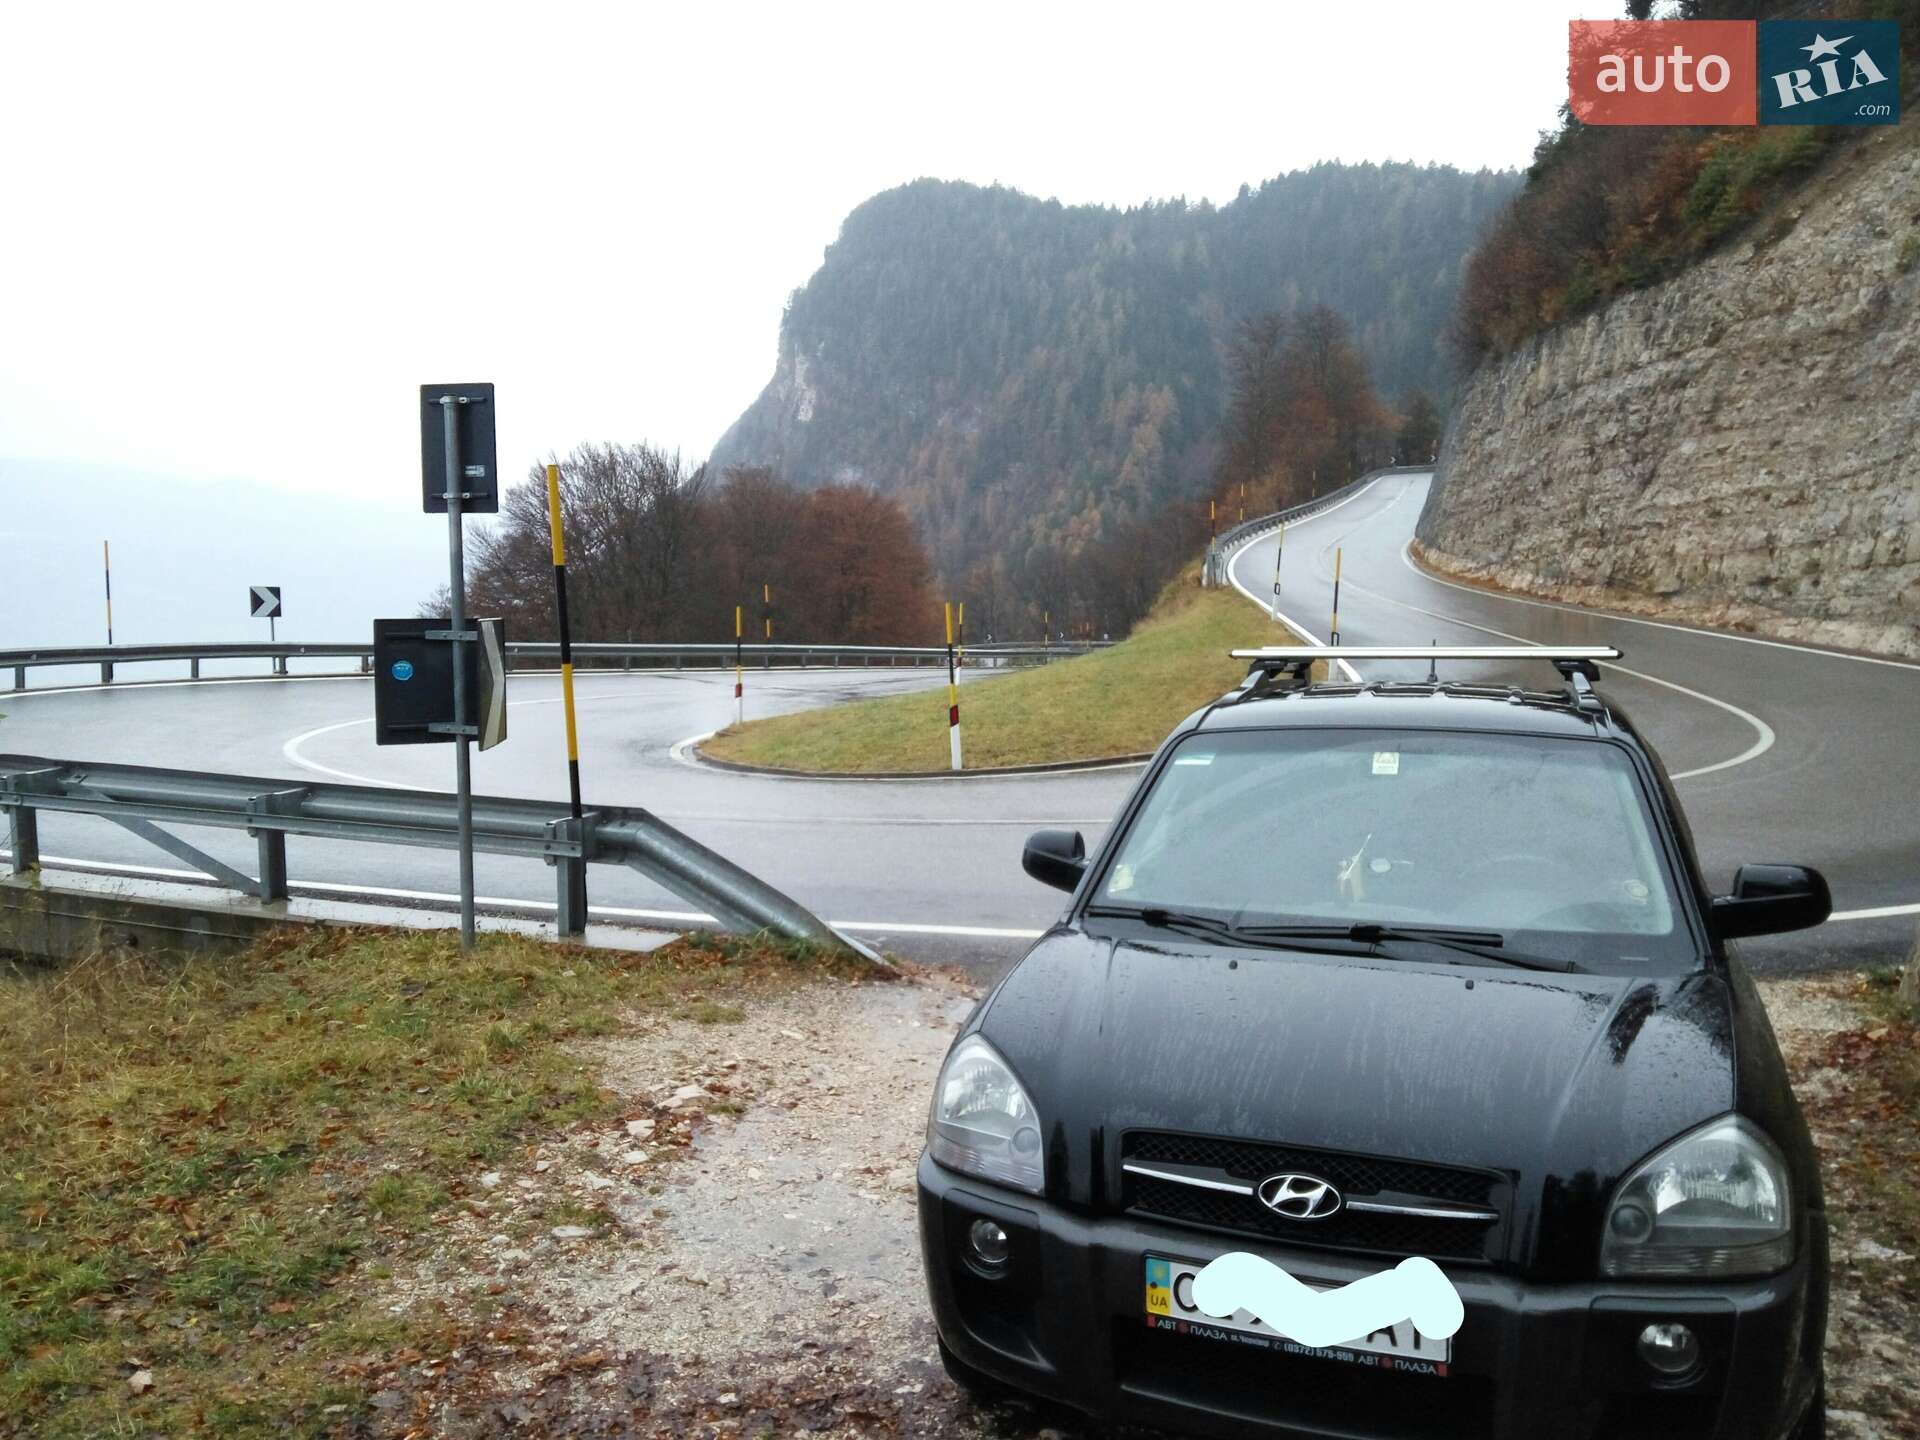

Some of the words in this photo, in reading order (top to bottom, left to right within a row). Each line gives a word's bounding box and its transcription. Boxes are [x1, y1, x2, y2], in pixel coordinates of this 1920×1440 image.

[1150, 1295, 1168, 1309] UA
[1190, 1325, 1228, 1341] ПЛАЗА
[1395, 1359, 1437, 1375] ПЛАЗА
